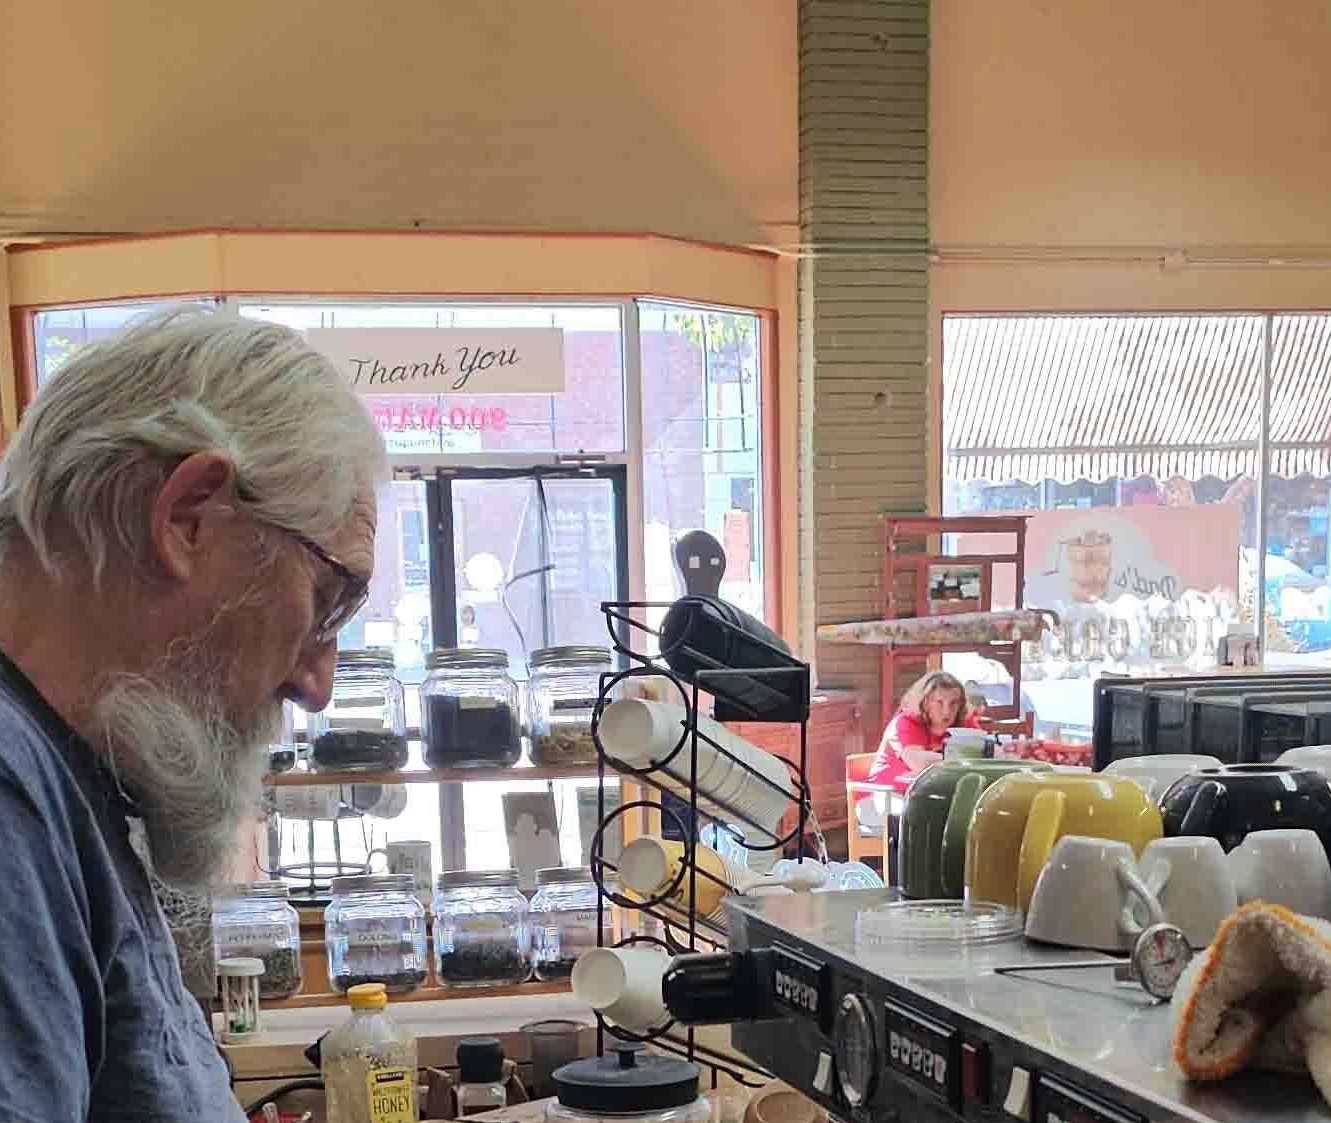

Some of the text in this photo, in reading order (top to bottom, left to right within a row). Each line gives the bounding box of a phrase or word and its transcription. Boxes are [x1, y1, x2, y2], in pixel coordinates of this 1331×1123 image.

[349, 347, 521, 390] Thank You
[373, 1095, 410, 1114] HONEY
